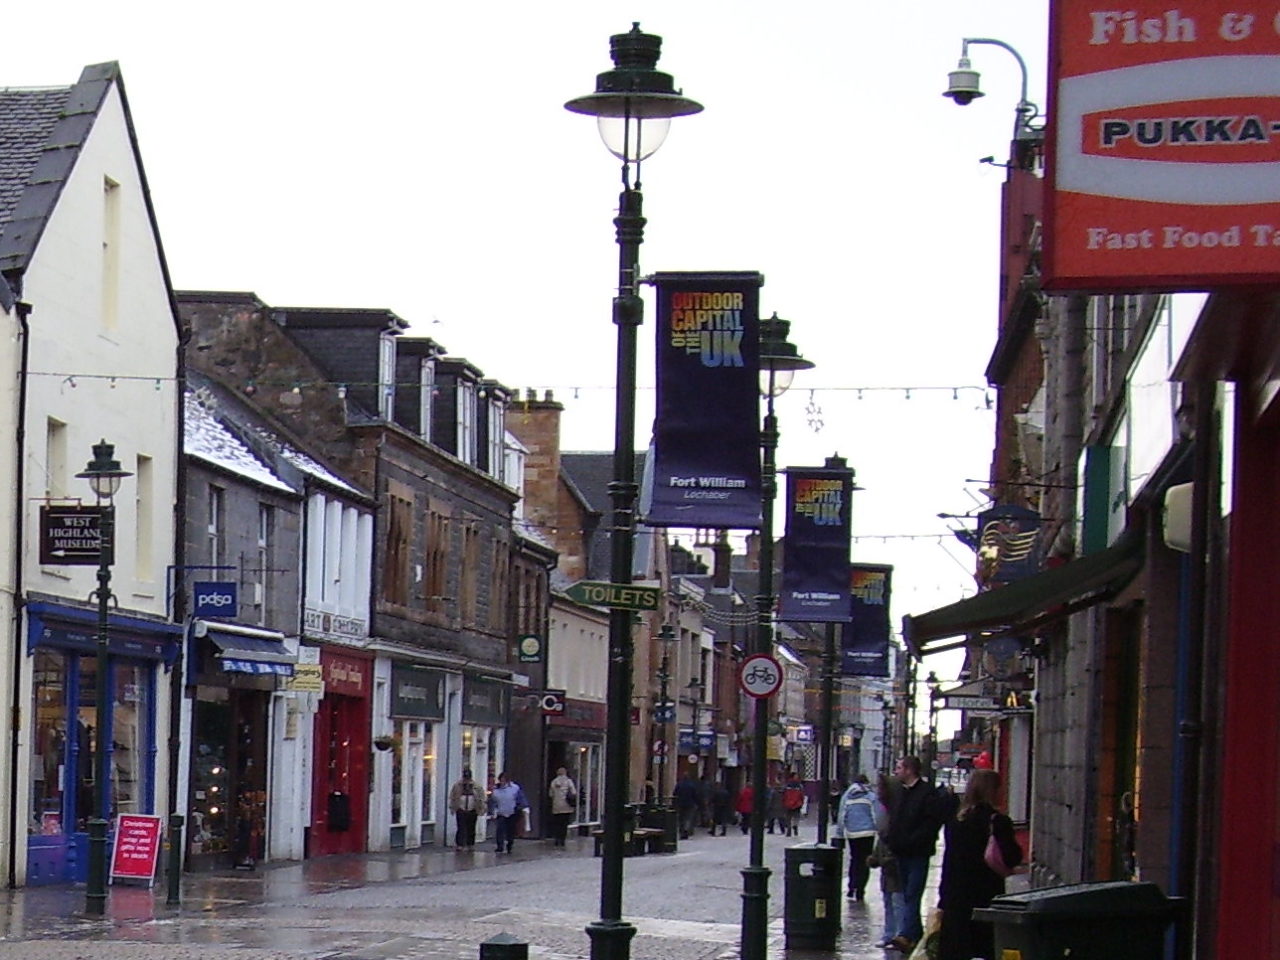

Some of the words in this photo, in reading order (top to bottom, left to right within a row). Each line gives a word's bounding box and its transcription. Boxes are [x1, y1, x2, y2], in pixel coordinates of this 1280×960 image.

[1089, 10, 1197, 45] Fish
[1219, 12, 1254, 42] &
[1087, 227, 1153, 250] Fast
[1163, 225, 1240, 248] Food
[672, 292, 744, 310] OUTDOOR
[671, 310, 744, 331] CAPITAL
[671, 331, 686, 347] OF
[686, 331, 701, 356] THE
[700, 331, 745, 368] UK
[669, 476, 697, 487] Fort
[699, 476, 746, 488] William
[683, 490, 733, 499] Lochaber
[63, 517, 91, 527] WEST
[198, 591, 232, 606] pdsa
[582, 584, 656, 606] TOILETS
